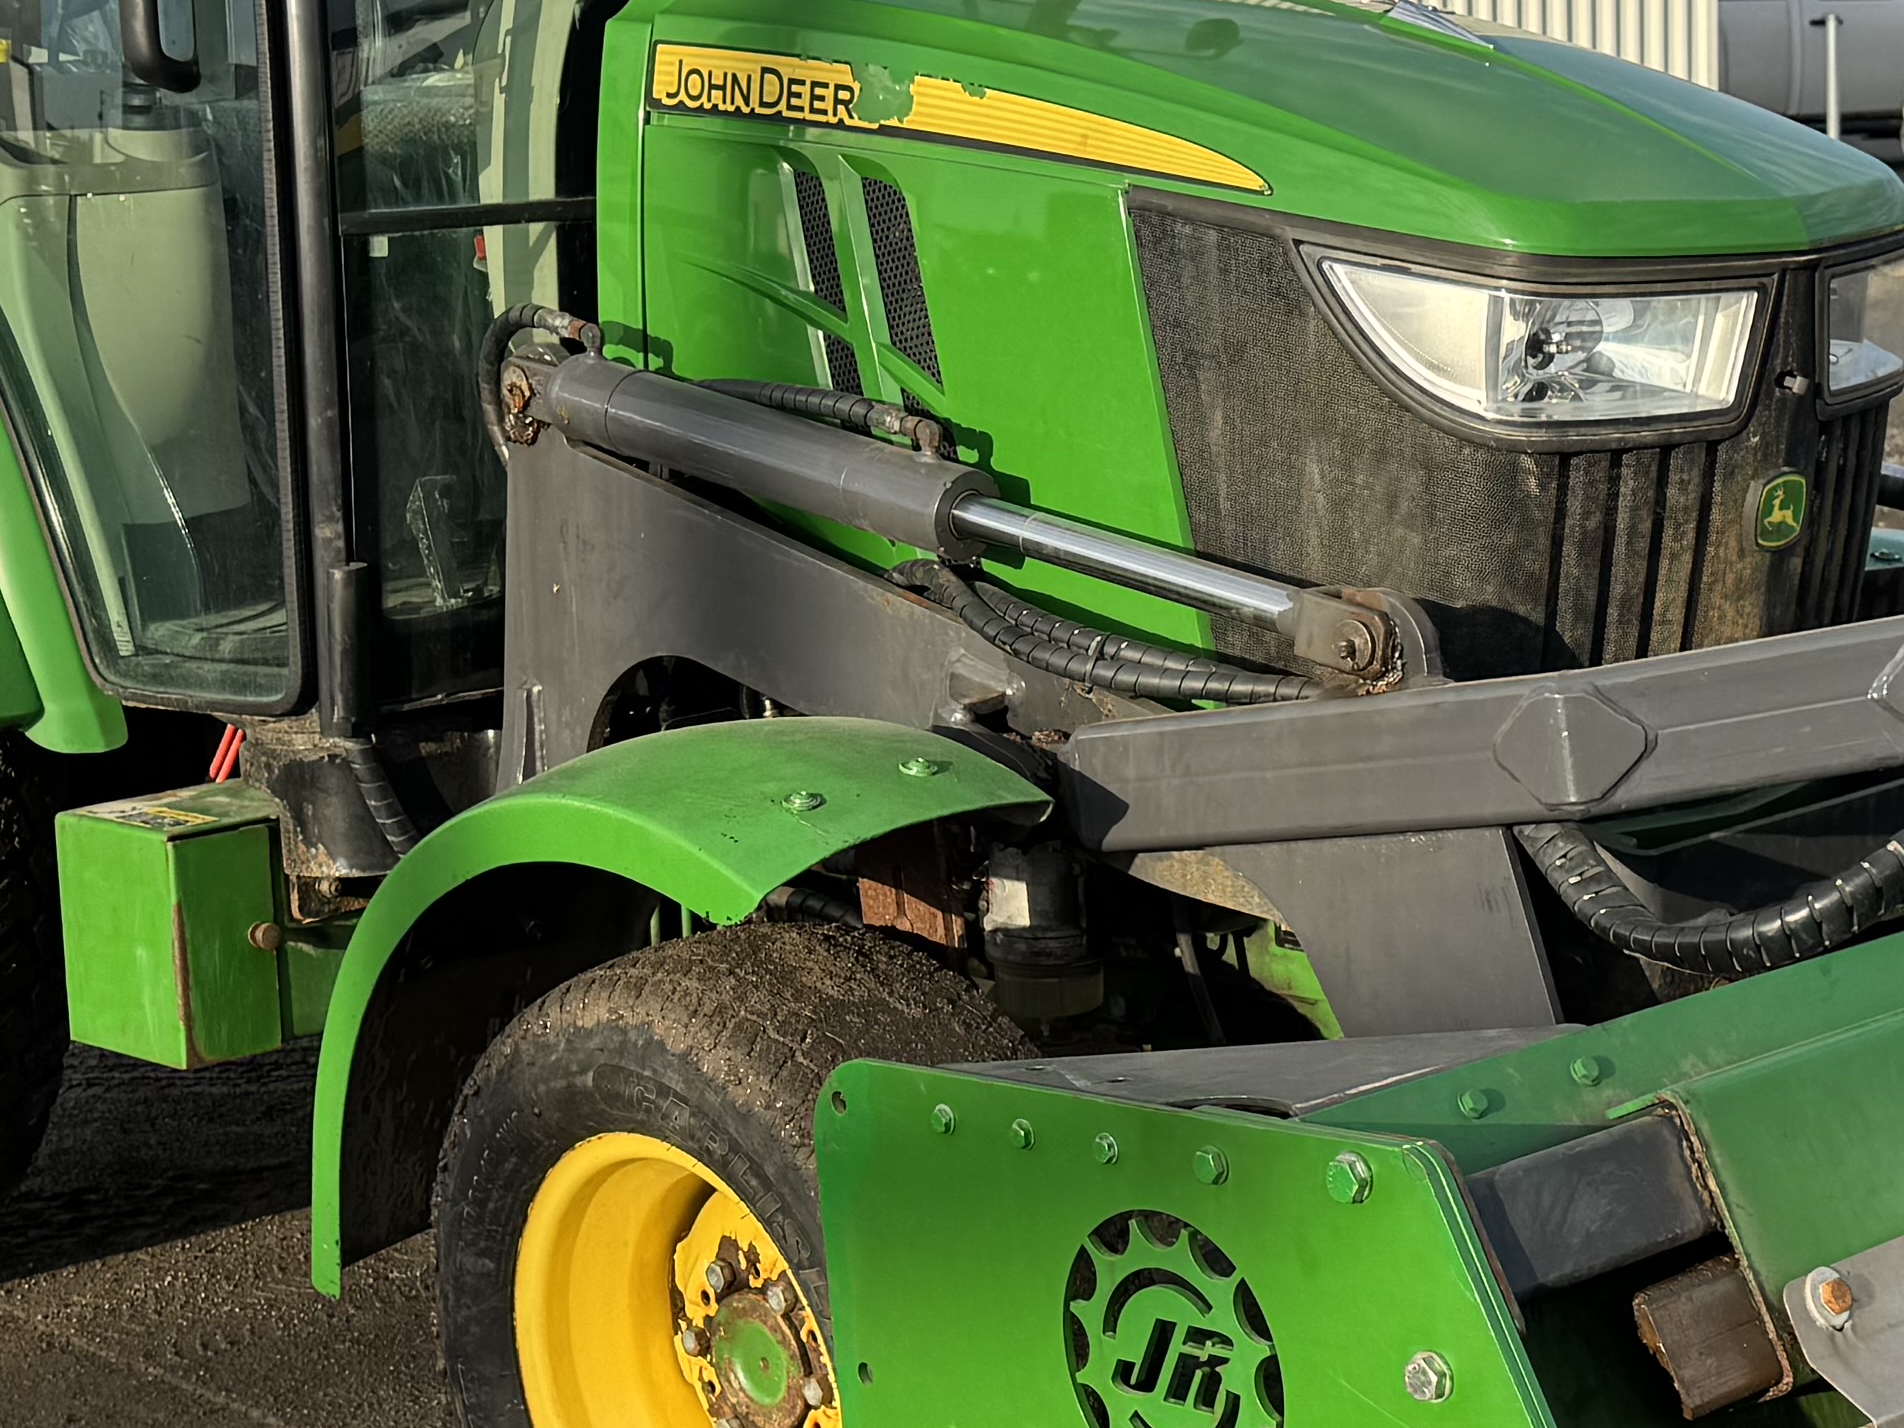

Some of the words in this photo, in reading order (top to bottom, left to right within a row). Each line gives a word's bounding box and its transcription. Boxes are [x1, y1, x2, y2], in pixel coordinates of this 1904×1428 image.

[665, 58, 752, 109] JOHN
[758, 66, 859, 120] DEER
[625, 1077, 832, 1320] CARLISL
[1111, 1318, 1234, 1414] JR
